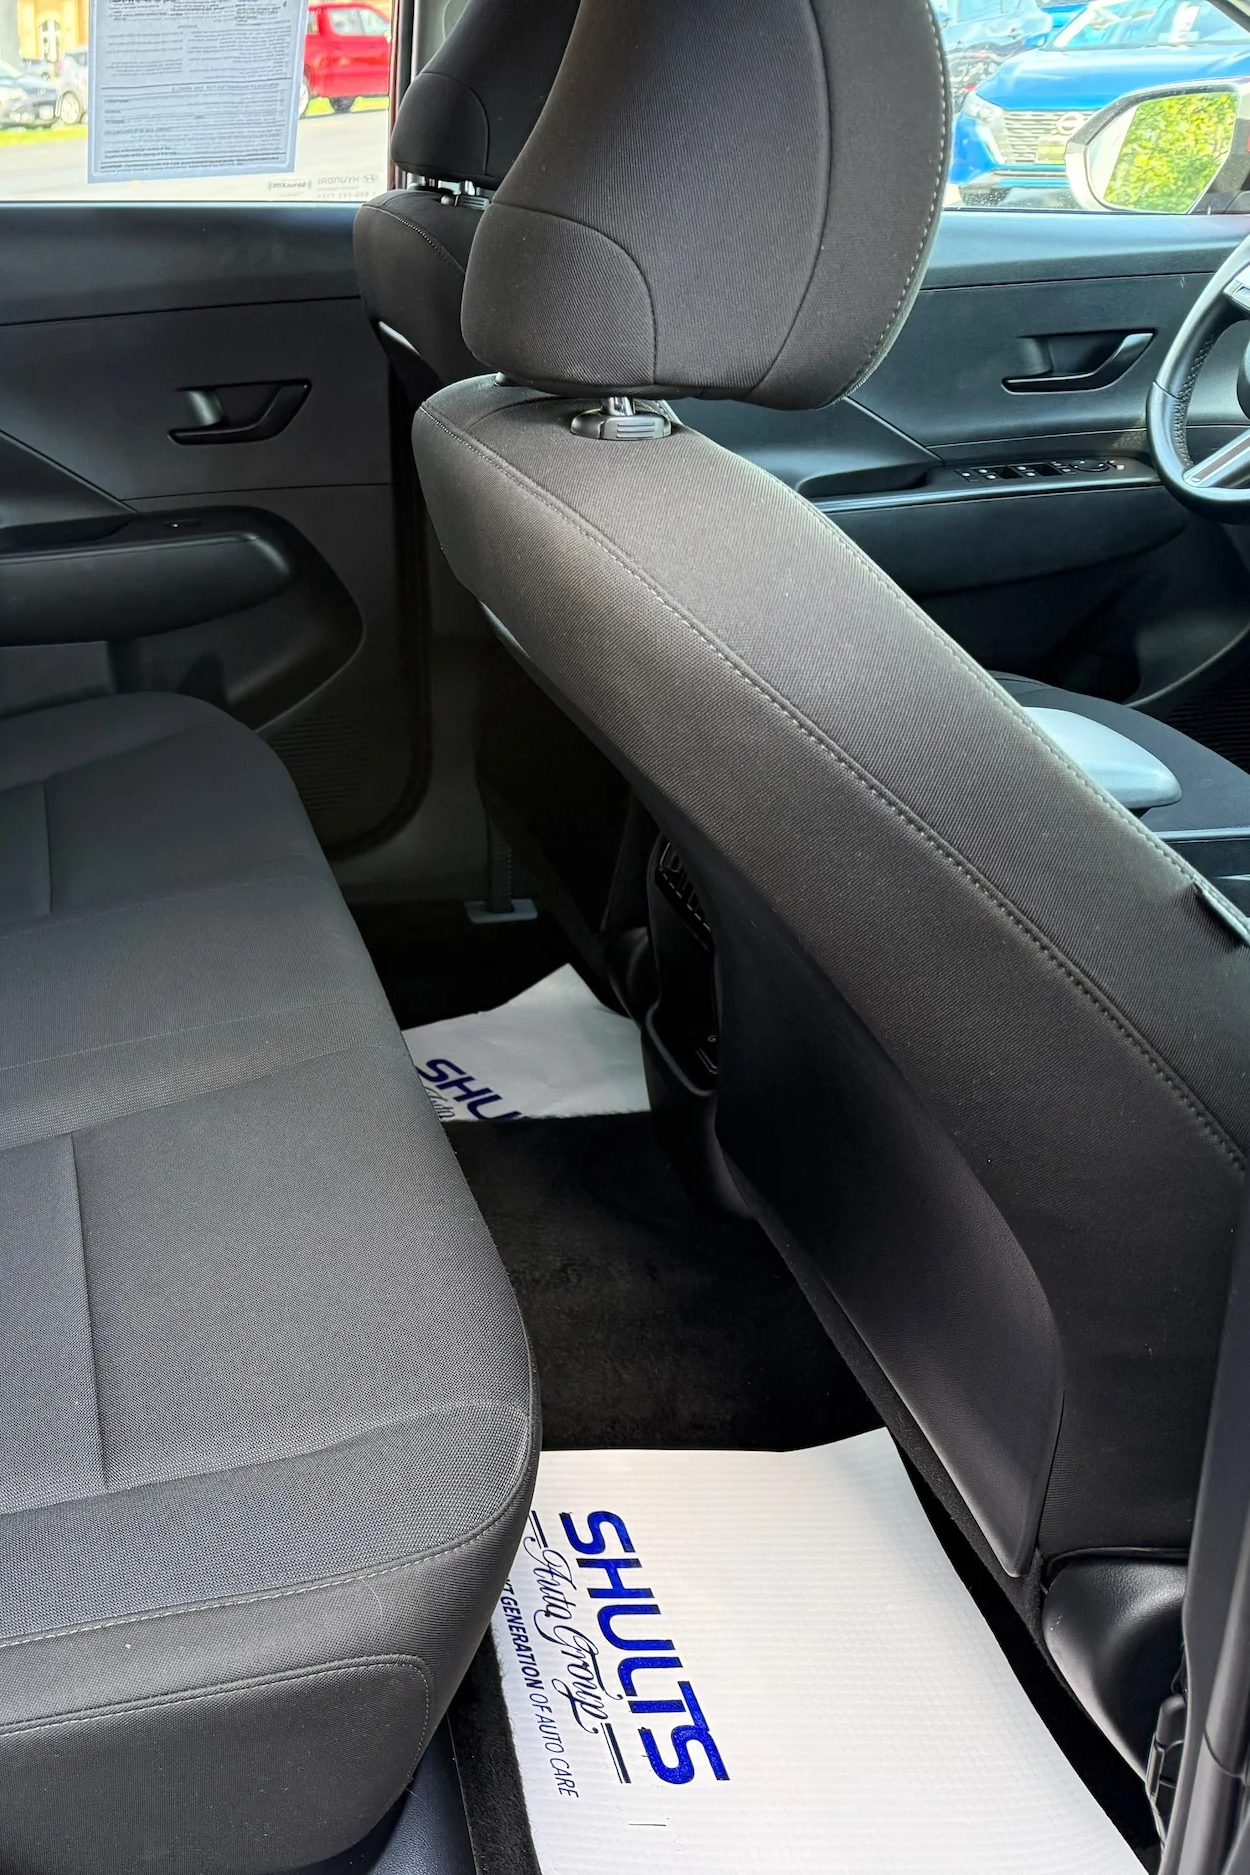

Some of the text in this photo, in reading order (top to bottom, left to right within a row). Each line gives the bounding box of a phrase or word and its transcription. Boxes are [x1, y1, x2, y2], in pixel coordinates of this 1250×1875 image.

[500, 1596, 545, 1690] GENERATION
[524, 1537, 624, 1735] Auto Group
[559, 1511, 731, 1785] SHULTS
[528, 1692, 553, 1715] OF
[536, 1714, 565, 1754] AUTO
[549, 1757, 579, 1799] CARE
